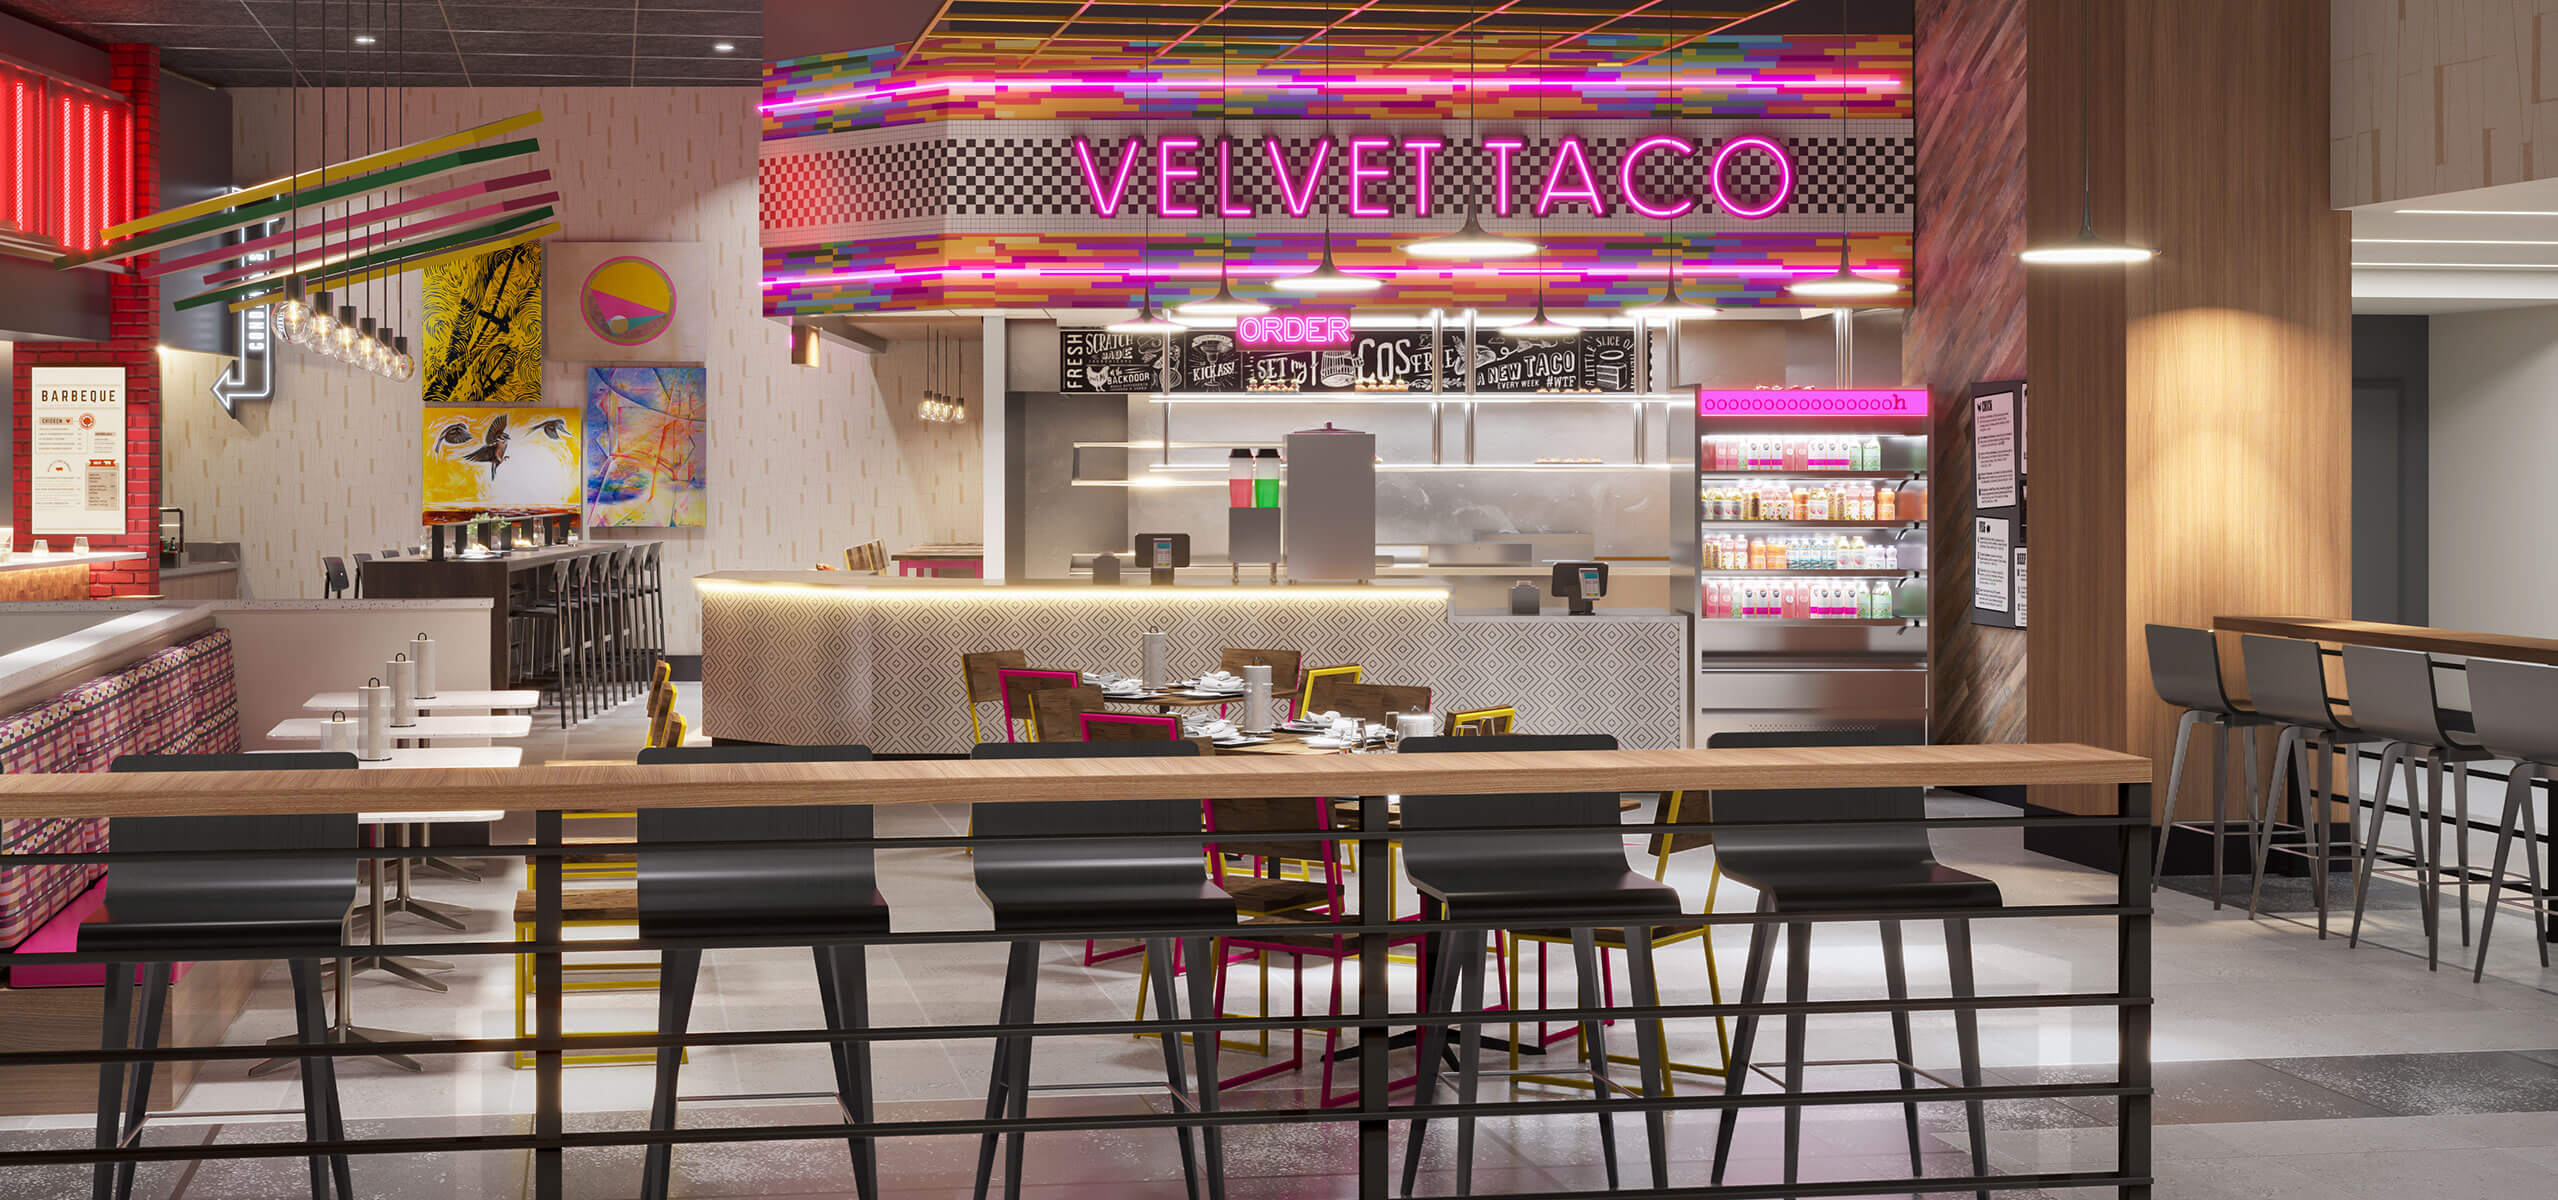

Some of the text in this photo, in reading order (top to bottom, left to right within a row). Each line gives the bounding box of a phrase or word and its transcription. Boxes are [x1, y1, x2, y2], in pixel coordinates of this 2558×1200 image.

[1075, 137, 1792, 218] VELVET TACO
[1239, 316, 1350, 343] ORDER
[1085, 333, 1134, 355] SCRATCH
[1595, 336, 1620, 348] SLICE
[1066, 334, 1083, 389] FRESH
[1256, 357, 1288, 380] SET
[1410, 348, 1455, 374] FRE
[1476, 350, 1575, 386] A NEW TACO
[1497, 375, 1577, 390] EVERY WEEK #WTF
[41, 389, 117, 402] BARBEQUE
